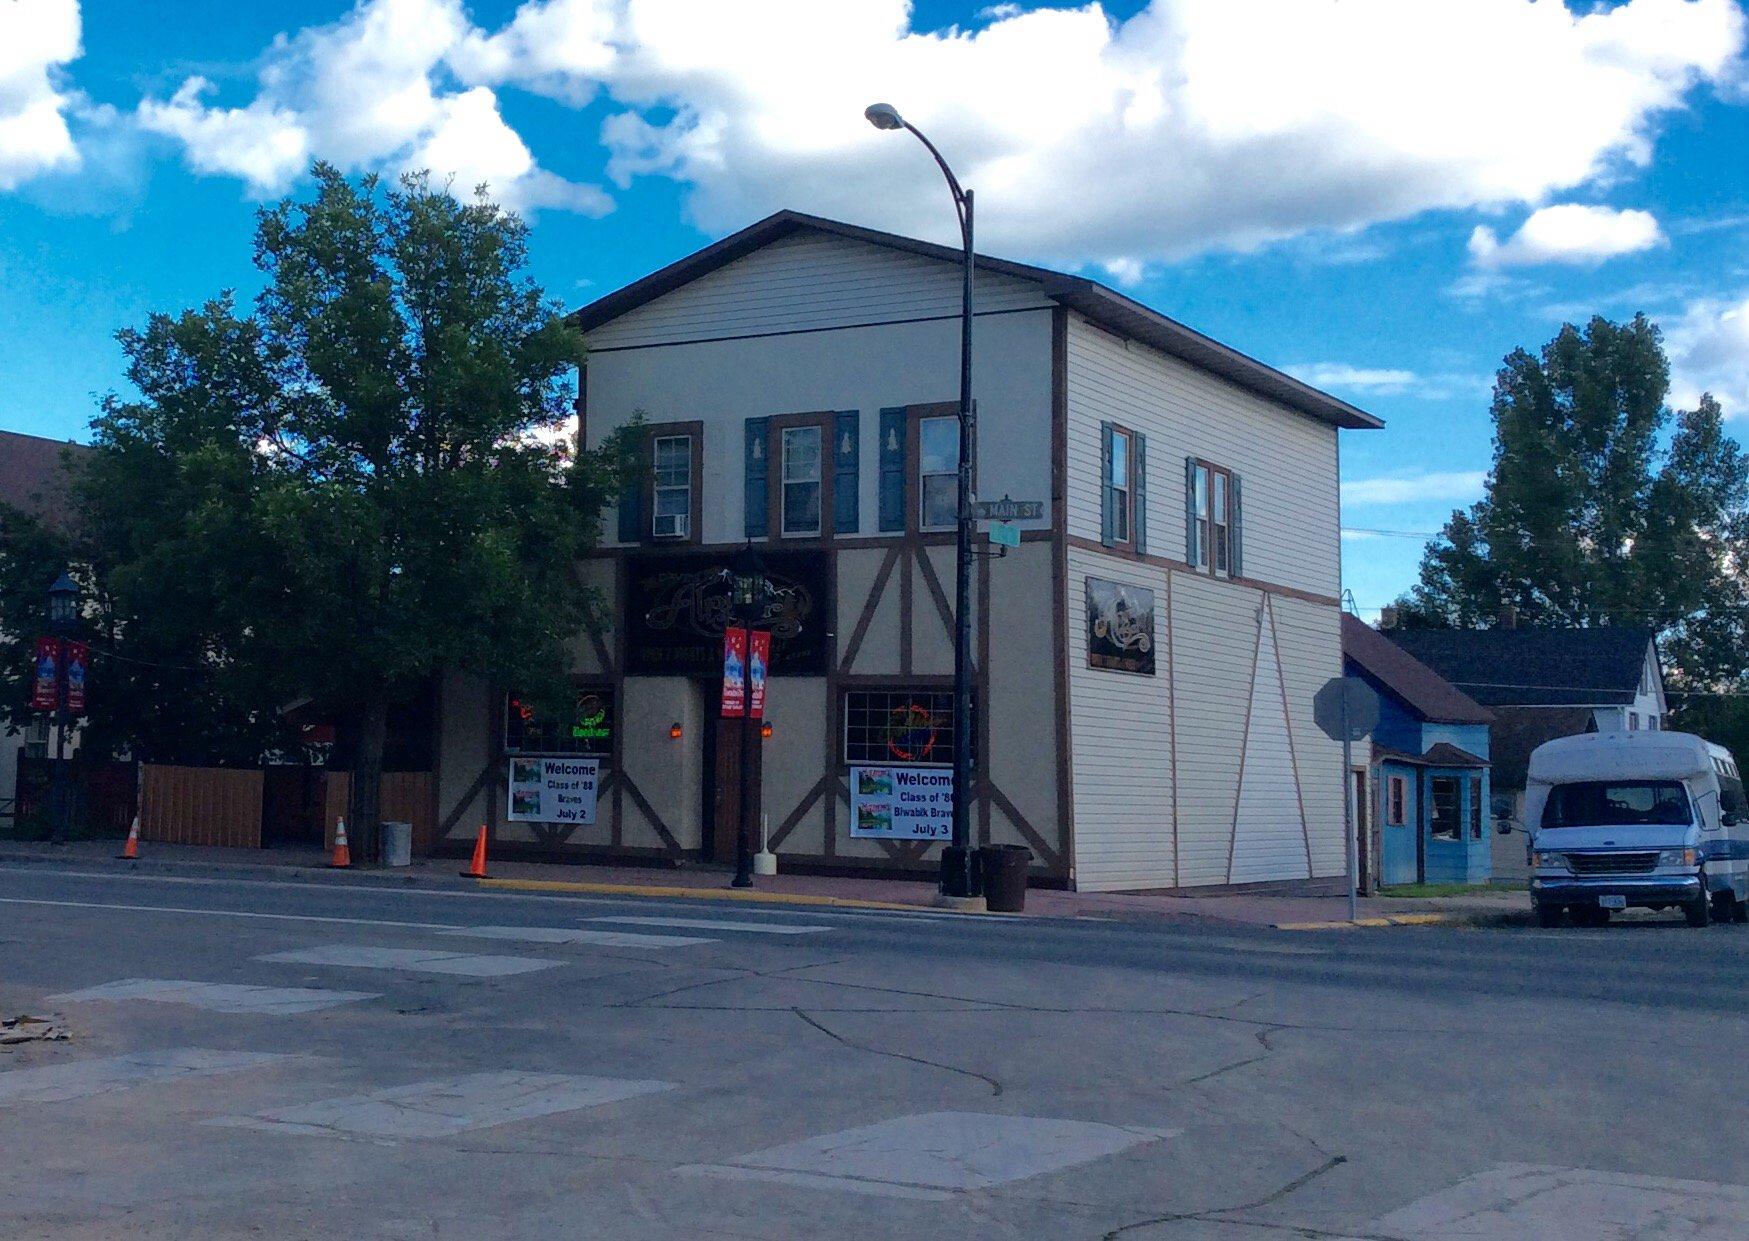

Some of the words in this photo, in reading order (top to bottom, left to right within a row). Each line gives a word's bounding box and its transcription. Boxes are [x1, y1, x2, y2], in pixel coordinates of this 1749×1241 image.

[989, 503, 1018, 516] MAIN
[545, 762, 596, 776] Welcome
[547, 780, 569, 790] Class
[571, 780, 579, 790] of
[896, 772, 954, 786] Welcom
[558, 793, 583, 804] Braves
[900, 791, 926, 803] Class
[929, 792, 940, 803] of
[557, 809, 577, 821] July
[580, 810, 586, 819] 2
[894, 806, 928, 818] Biwabik
[912, 824, 937, 837] July
[941, 825, 949, 835] 3
